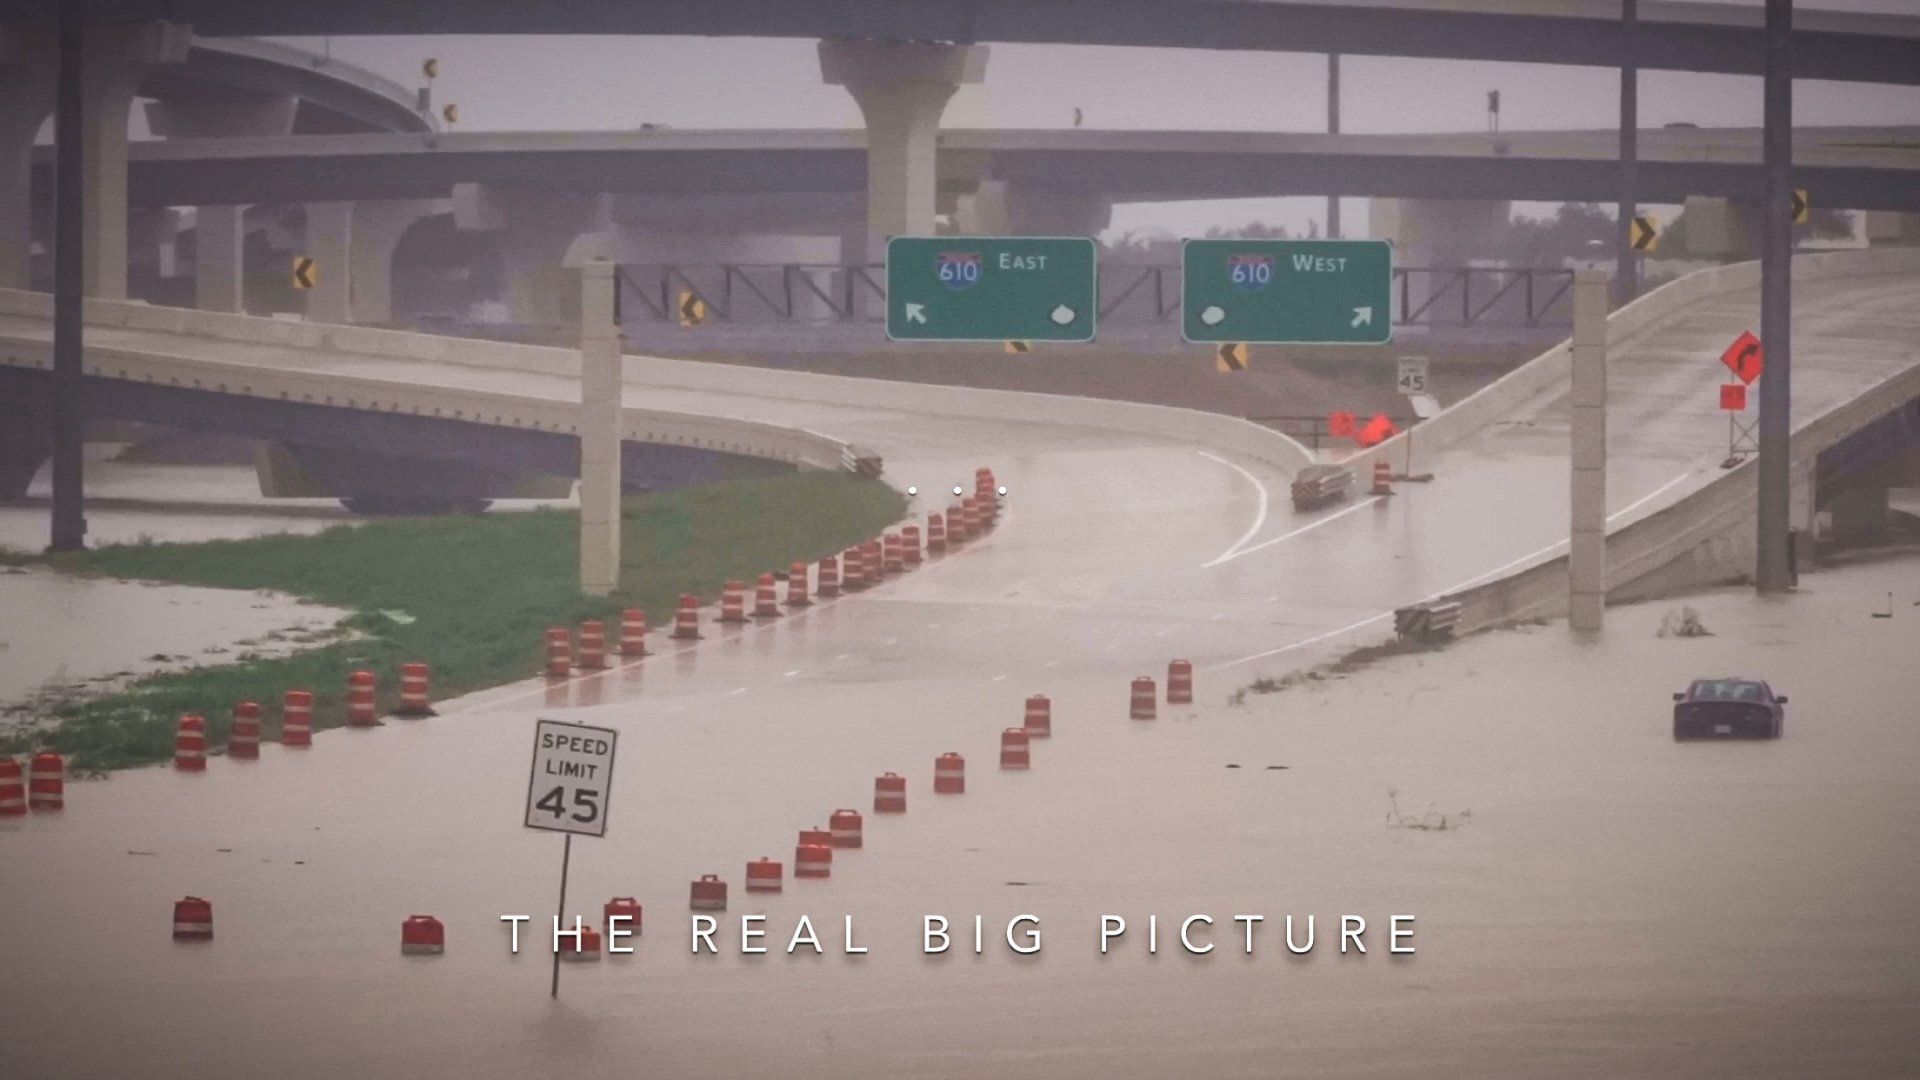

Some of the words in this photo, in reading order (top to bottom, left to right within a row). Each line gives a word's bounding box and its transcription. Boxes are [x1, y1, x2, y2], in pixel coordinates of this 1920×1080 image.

[940, 260, 978, 281] 610
[999, 253, 1047, 270] EAST
[1231, 263, 1270, 283] 610
[1292, 254, 1347, 272] WEST
[1400, 375, 1424, 391] 45
[542, 733, 608, 755] SPEED
[545, 759, 597, 780] LIMIT
[535, 785, 598, 823] 45
